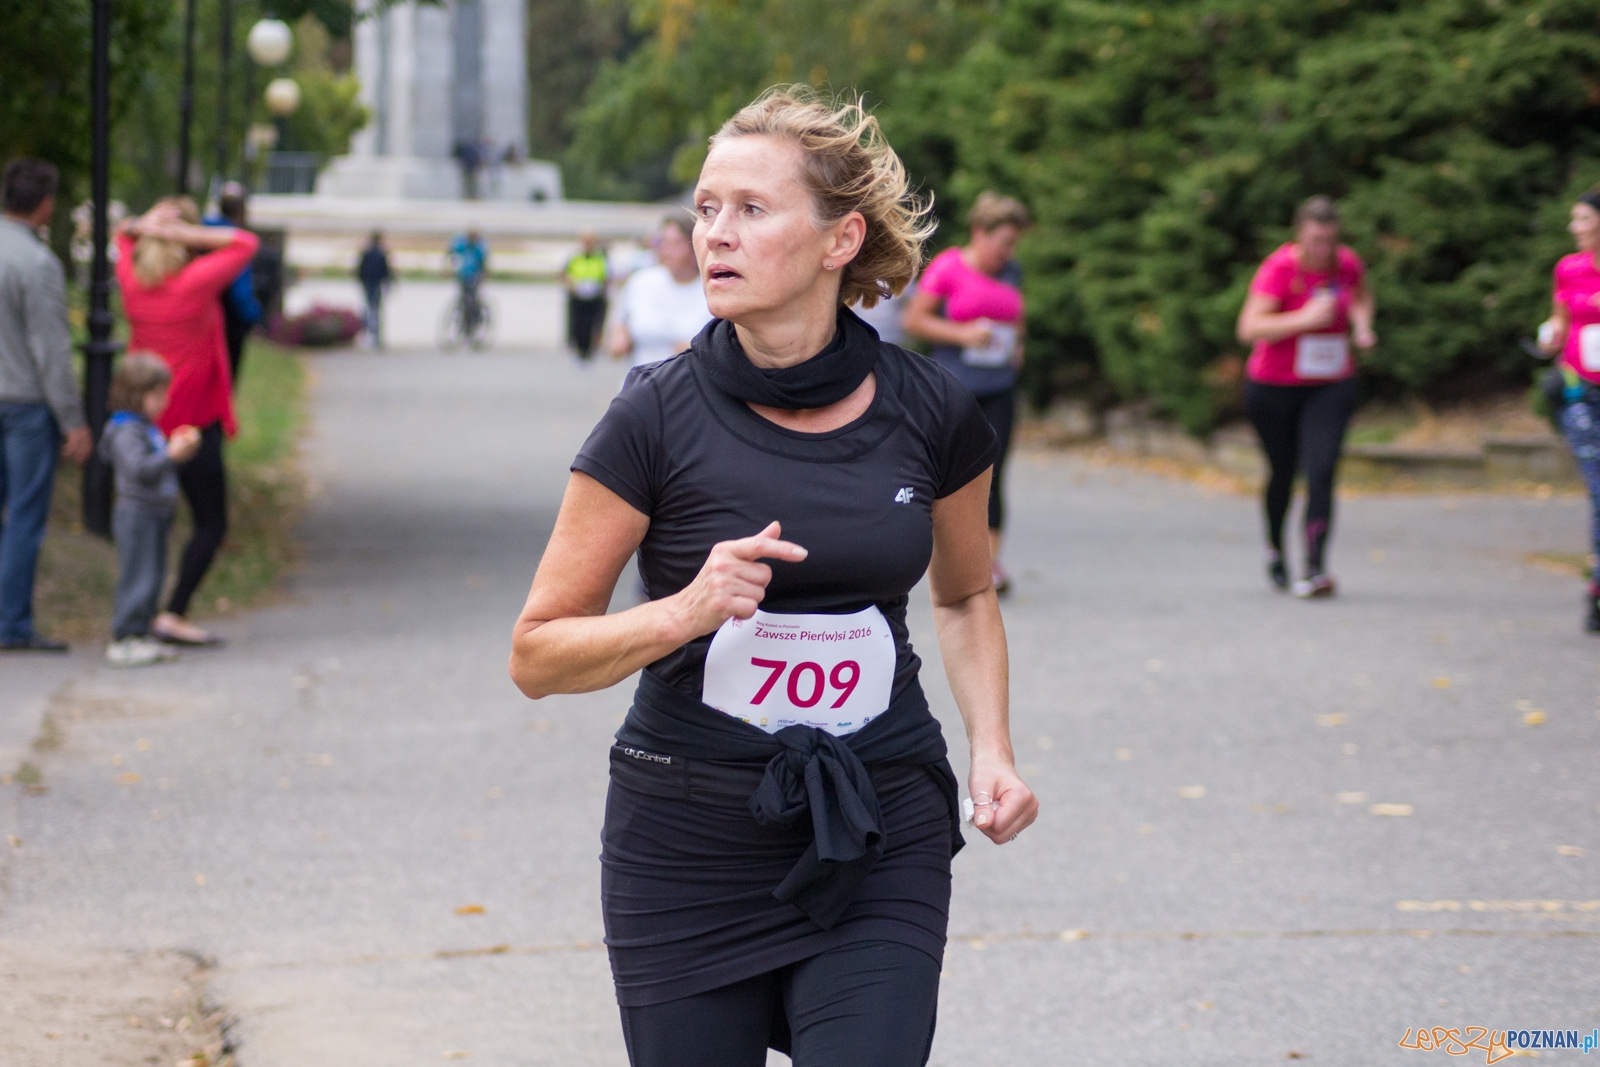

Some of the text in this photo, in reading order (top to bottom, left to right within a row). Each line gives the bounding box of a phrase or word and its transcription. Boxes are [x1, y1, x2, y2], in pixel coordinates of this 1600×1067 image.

[895, 487, 914, 503] 4F
[755, 626, 872, 642] Zawsze Pier(w)si 2016
[749, 657, 860, 709] 709
